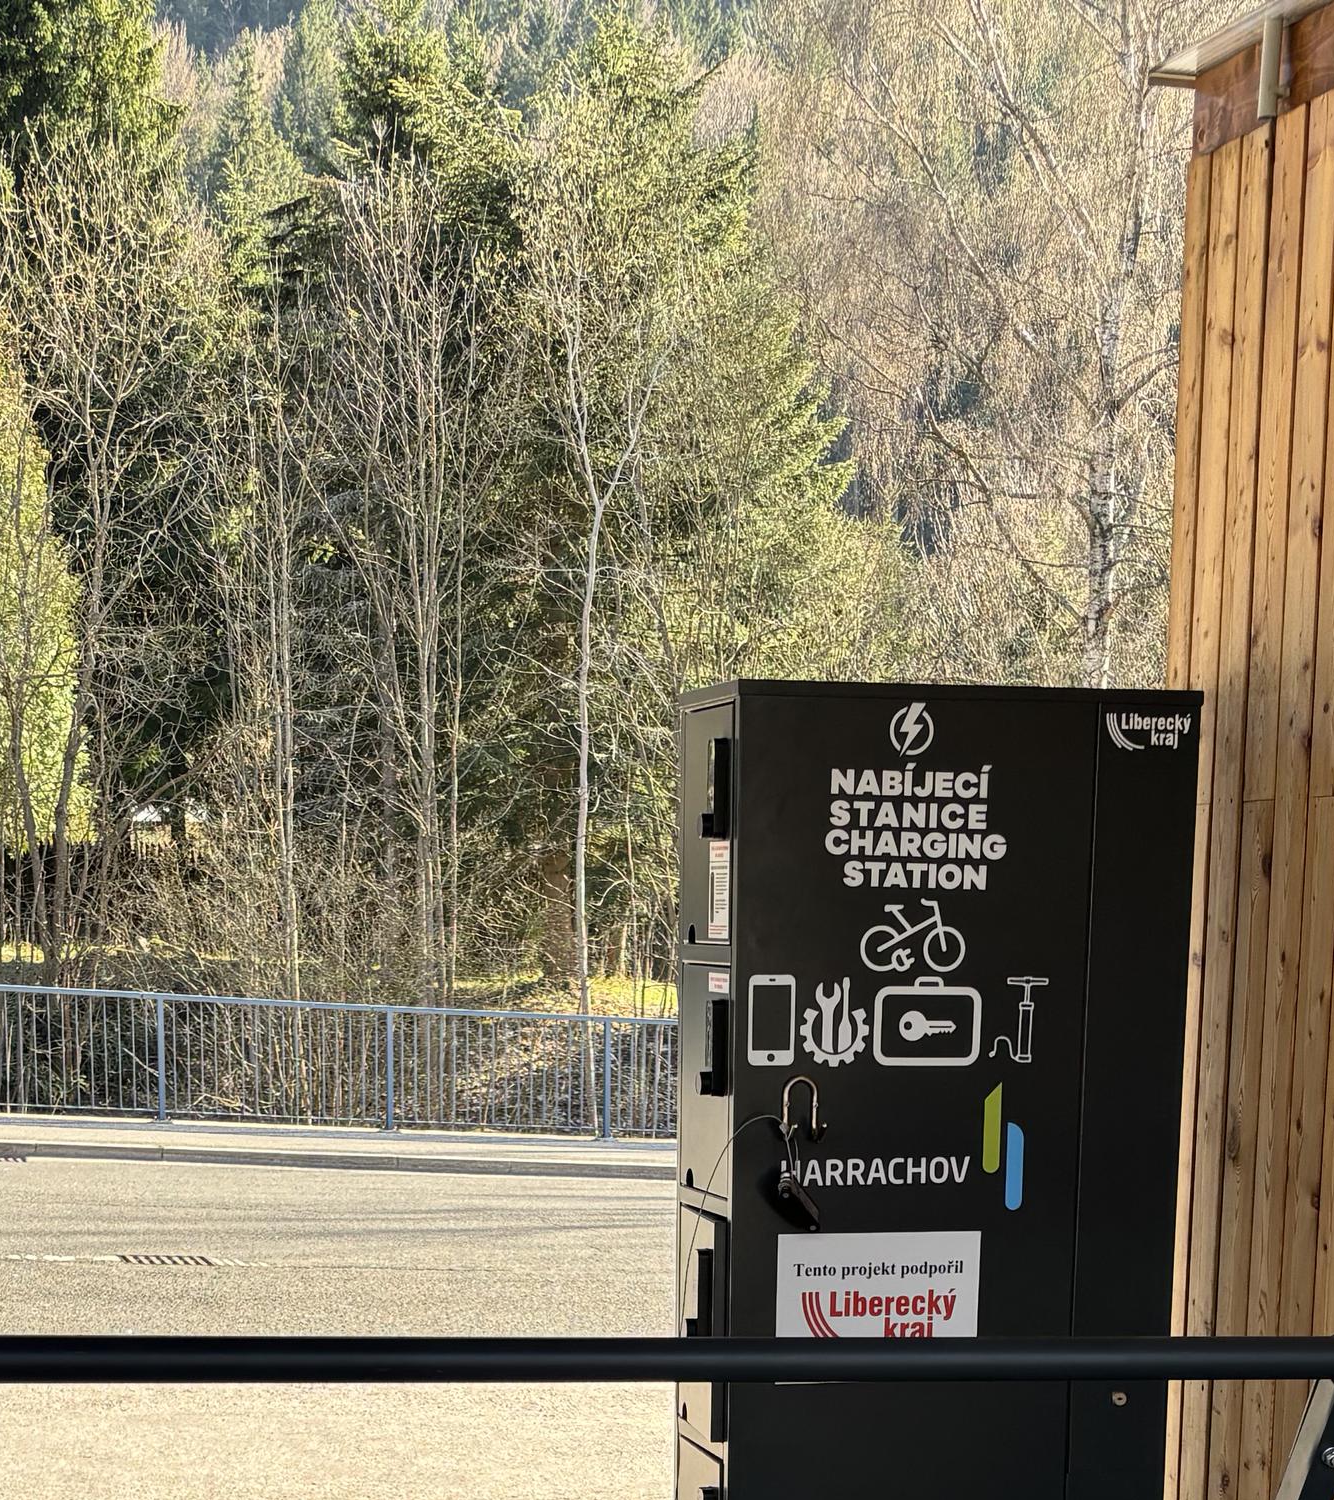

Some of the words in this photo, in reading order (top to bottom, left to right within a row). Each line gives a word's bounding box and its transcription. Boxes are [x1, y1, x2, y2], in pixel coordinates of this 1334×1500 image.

[1121, 712, 1192, 734] Liberecký
[1150, 729, 1179, 750] kraj
[830, 762, 993, 799] NABÍJECÍ
[829, 799, 988, 830] STANICE
[824, 828, 1008, 861] CHARGING
[842, 860, 988, 891] STATION
[793, 1263, 837, 1277] Tento
[841, 1261, 896, 1280] projekt
[900, 1260, 964, 1278] podpořil
[829, 1288, 957, 1321] Liberecký
